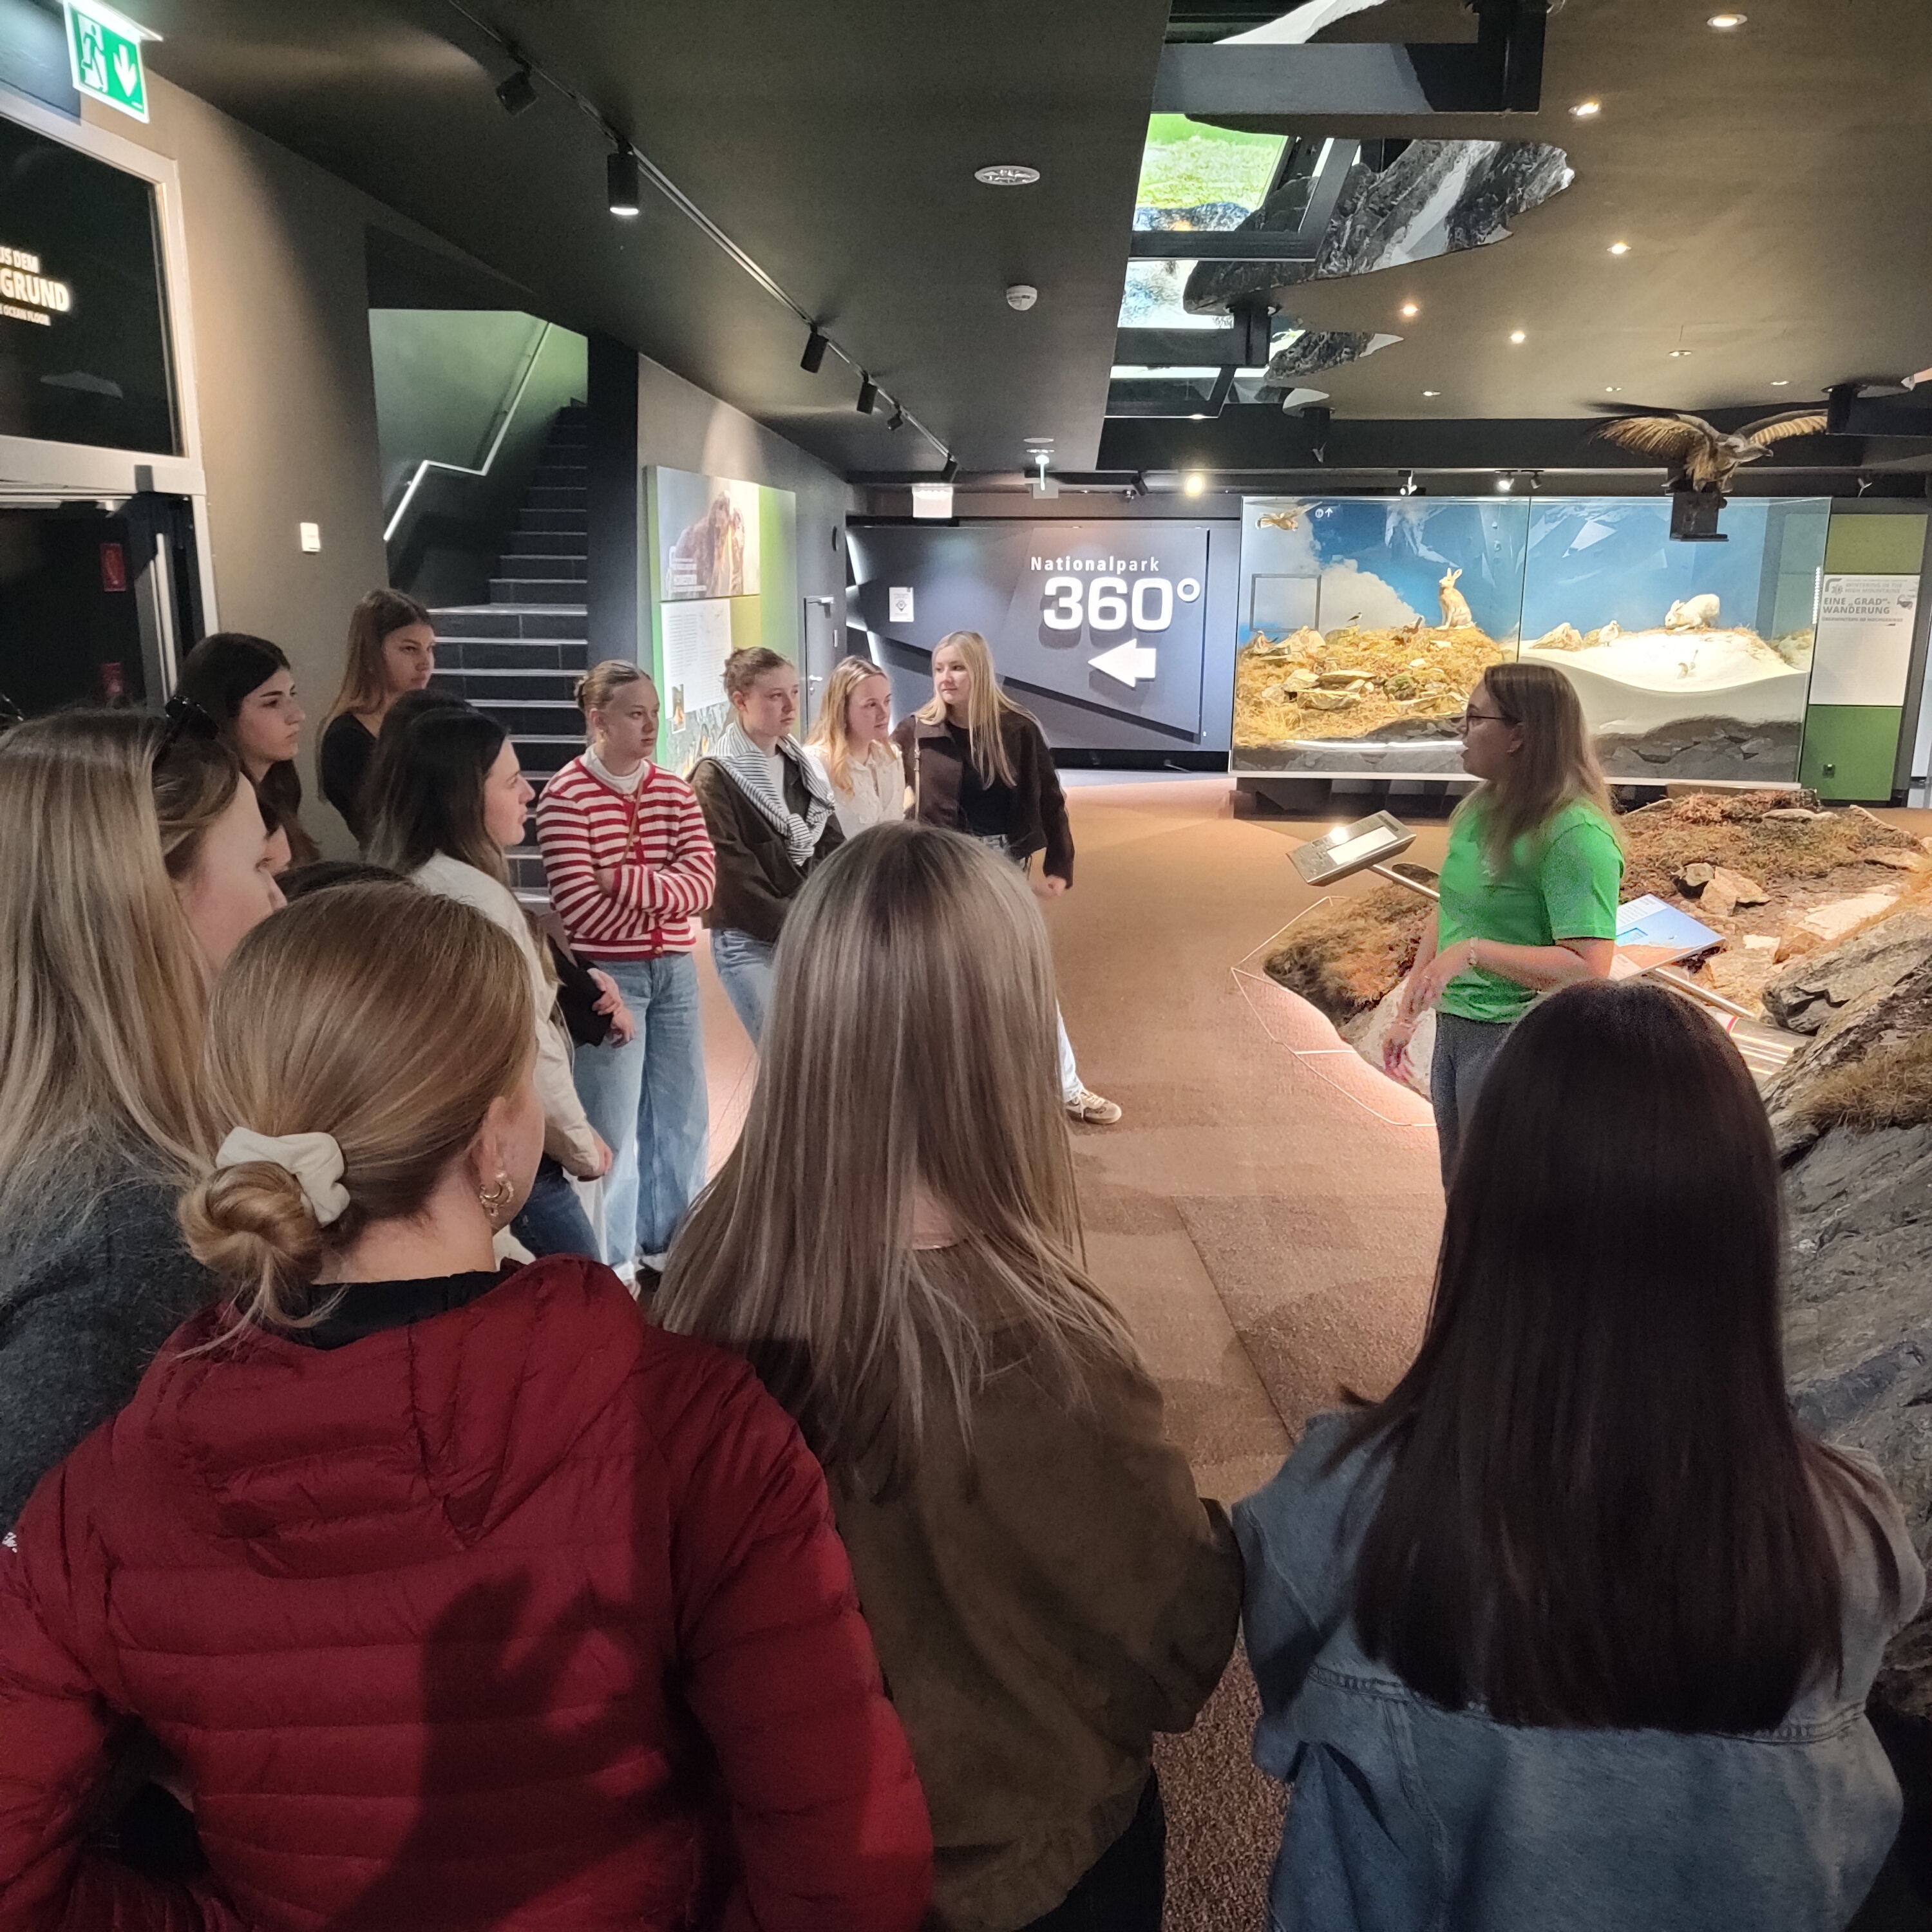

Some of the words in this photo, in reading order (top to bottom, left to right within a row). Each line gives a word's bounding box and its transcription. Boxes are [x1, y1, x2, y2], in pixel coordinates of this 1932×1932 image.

[13, 249, 40, 274] DEM
[0, 268, 71, 312] GRUND
[1030, 556, 1159, 574] Nationalpark
[1823, 606, 1890, 614] WANDERUNG
